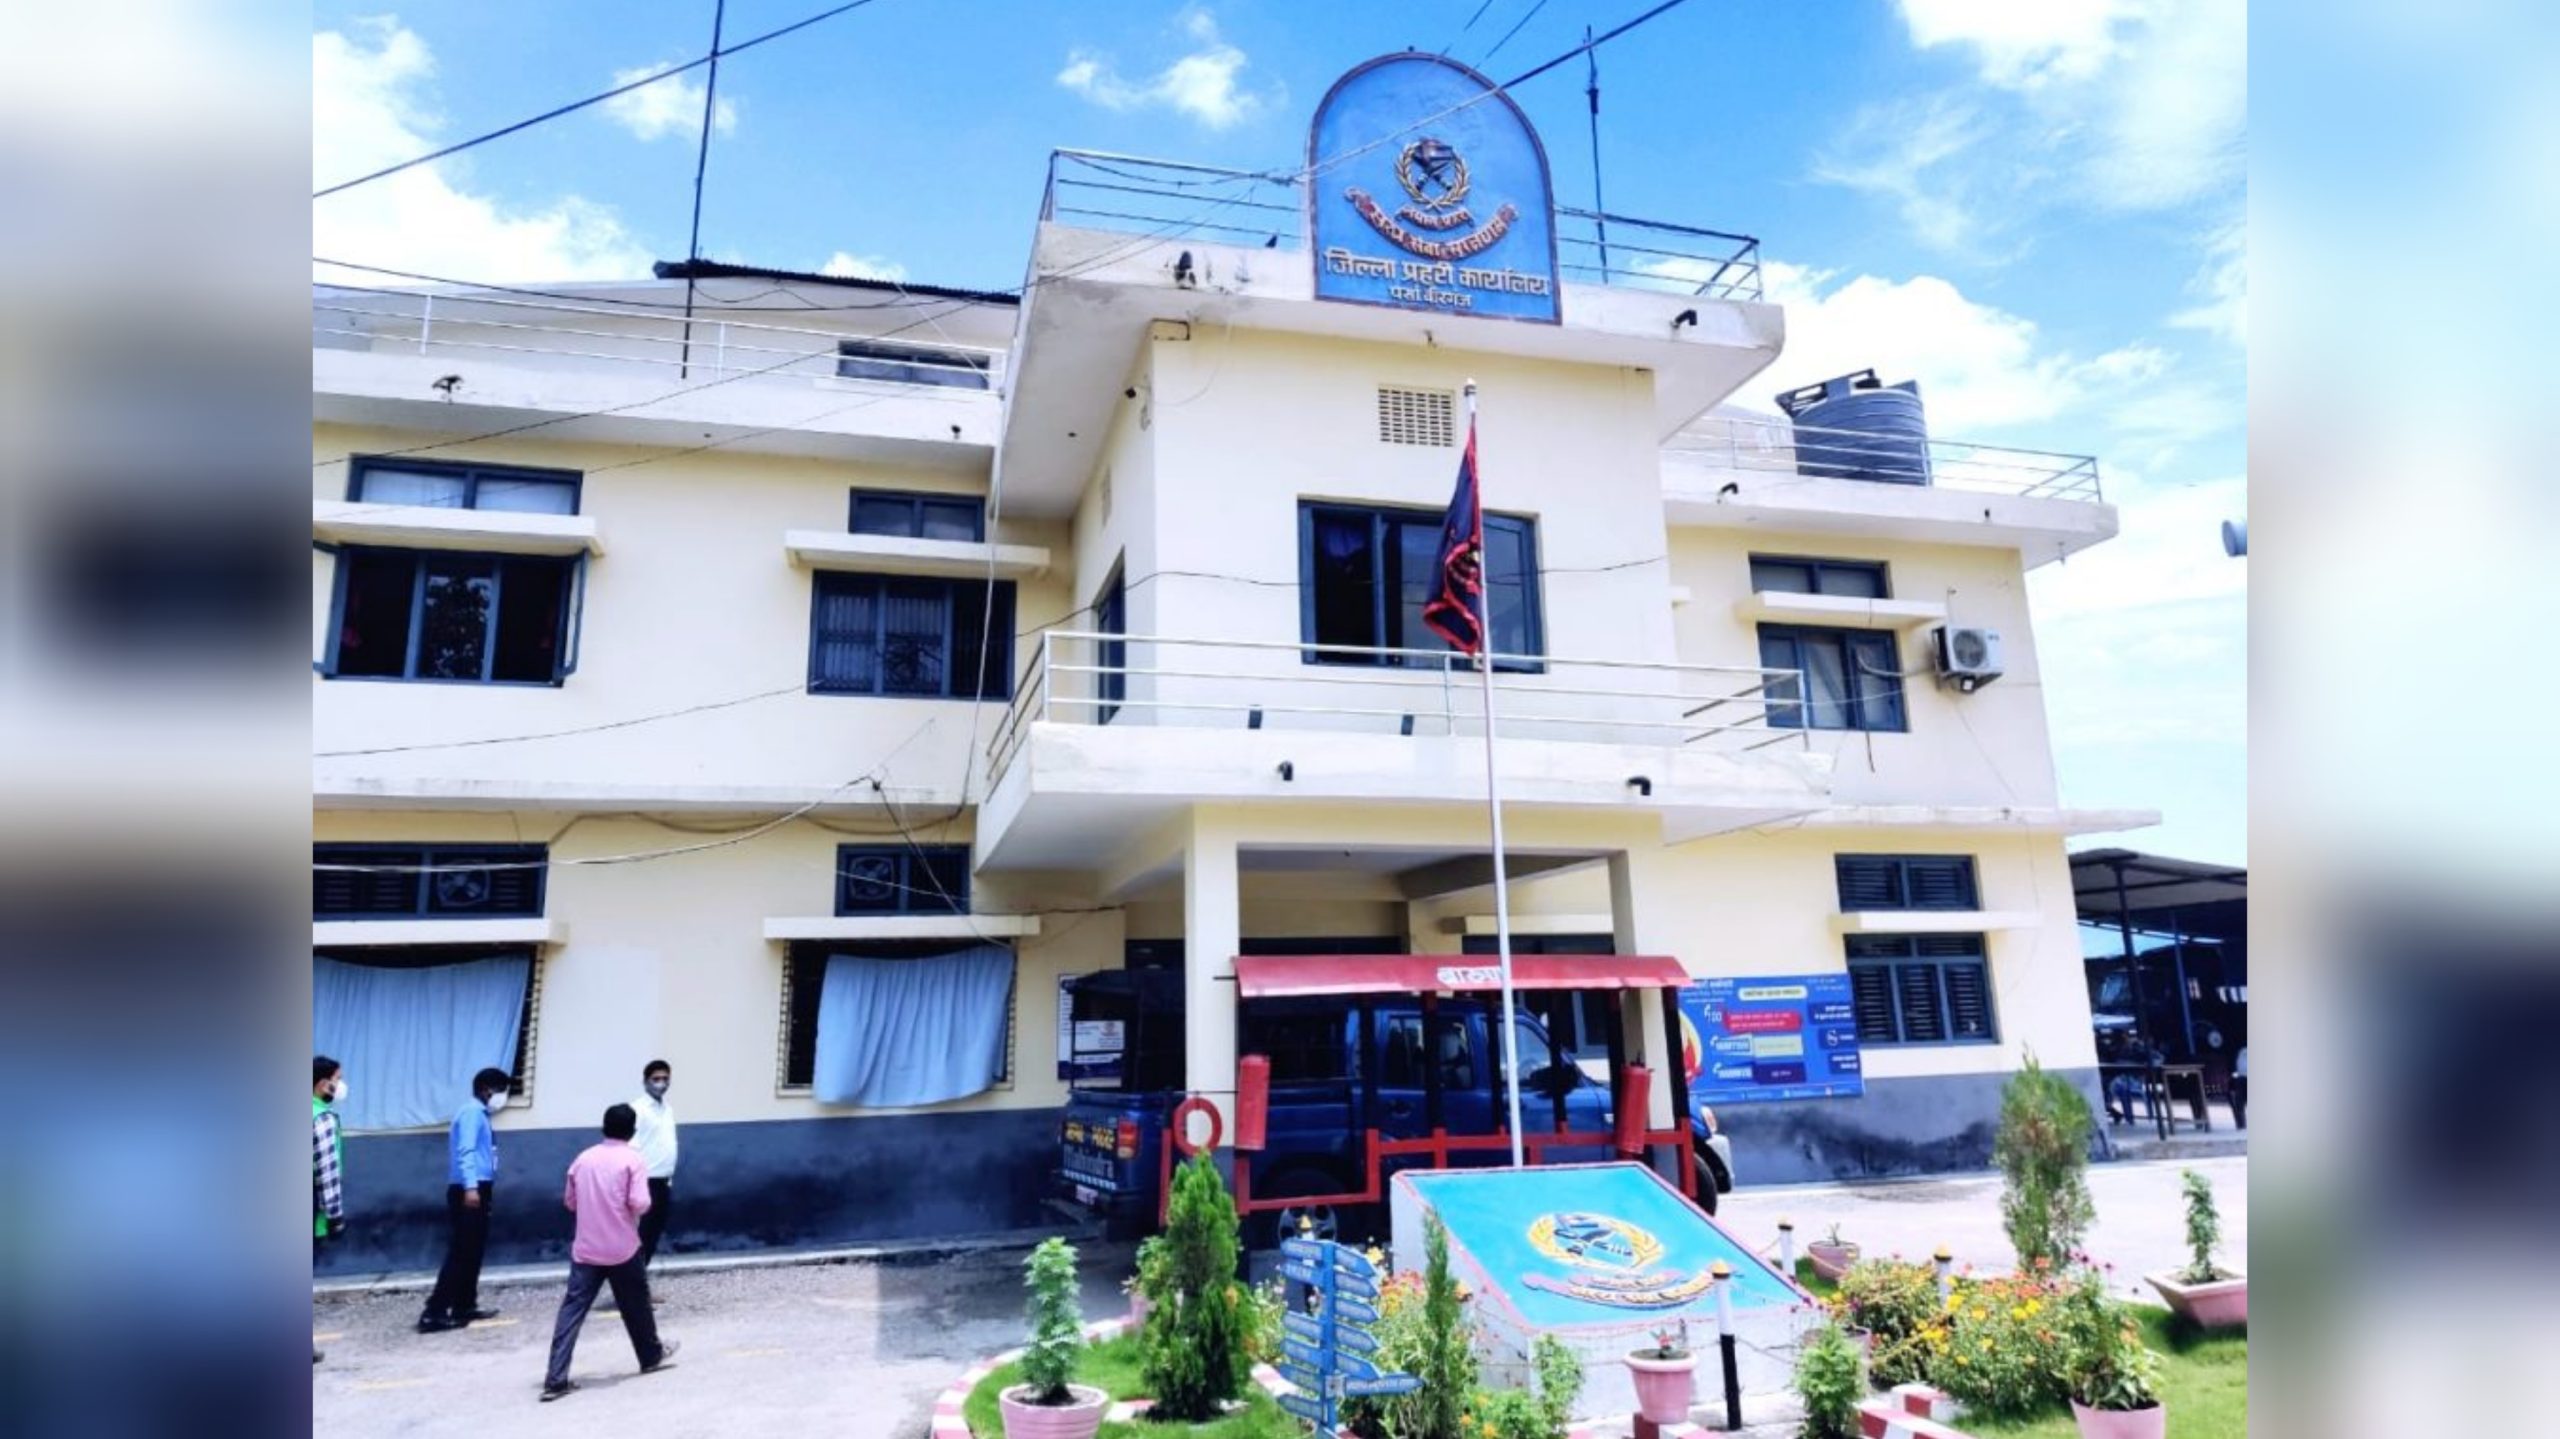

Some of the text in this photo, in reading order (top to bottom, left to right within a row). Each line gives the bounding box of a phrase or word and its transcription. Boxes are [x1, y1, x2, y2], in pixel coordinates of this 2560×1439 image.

[1324, 246, 1550, 296] जिल्ला प्रहरी कार्यालय
